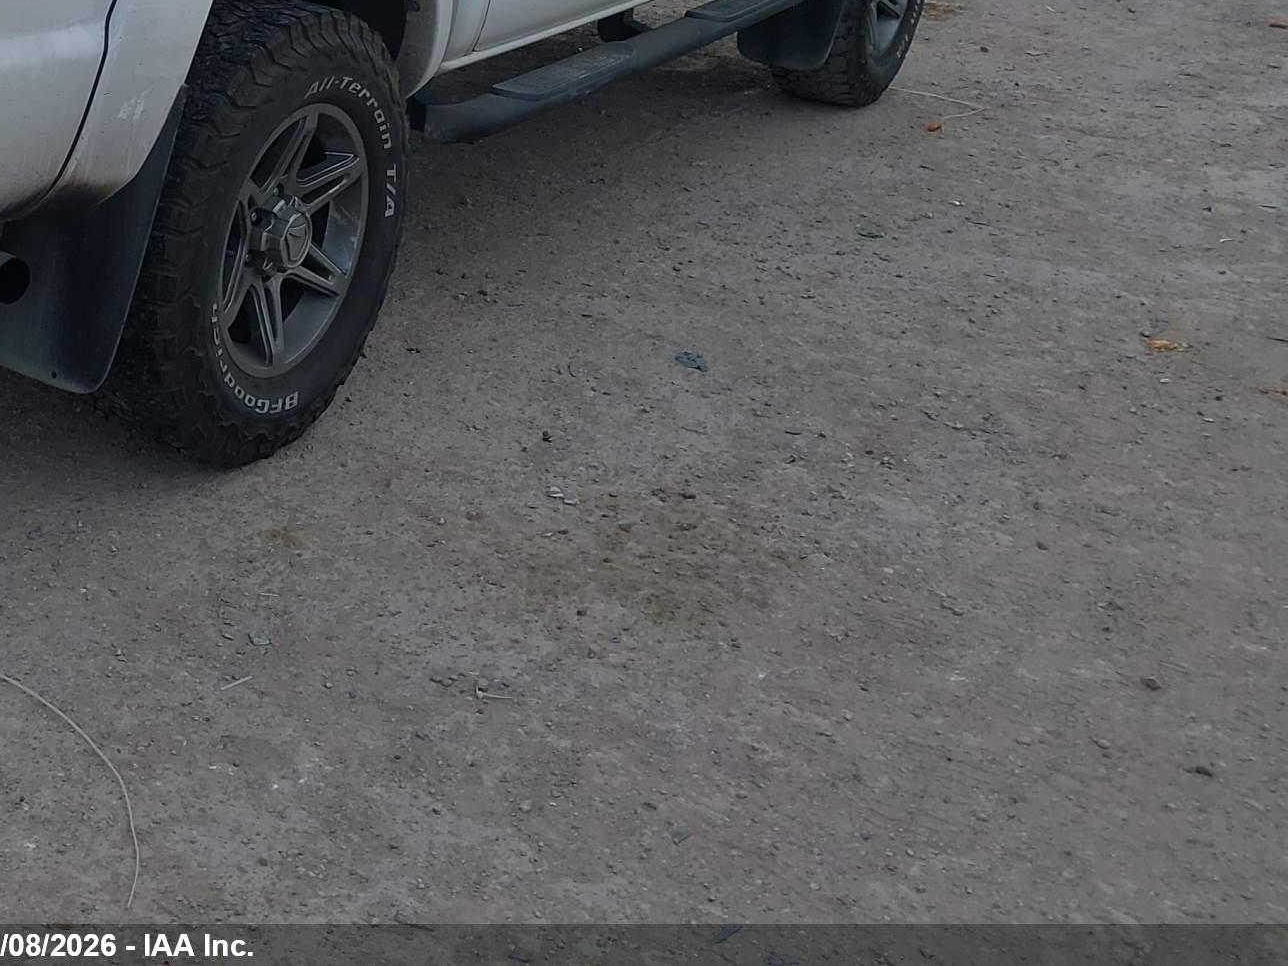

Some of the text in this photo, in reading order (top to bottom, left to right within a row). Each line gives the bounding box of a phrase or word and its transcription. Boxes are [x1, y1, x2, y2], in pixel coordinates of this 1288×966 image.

[304, 75, 397, 218] All-Terrain T/A
[211, 302, 300, 414] BFGoodrich
